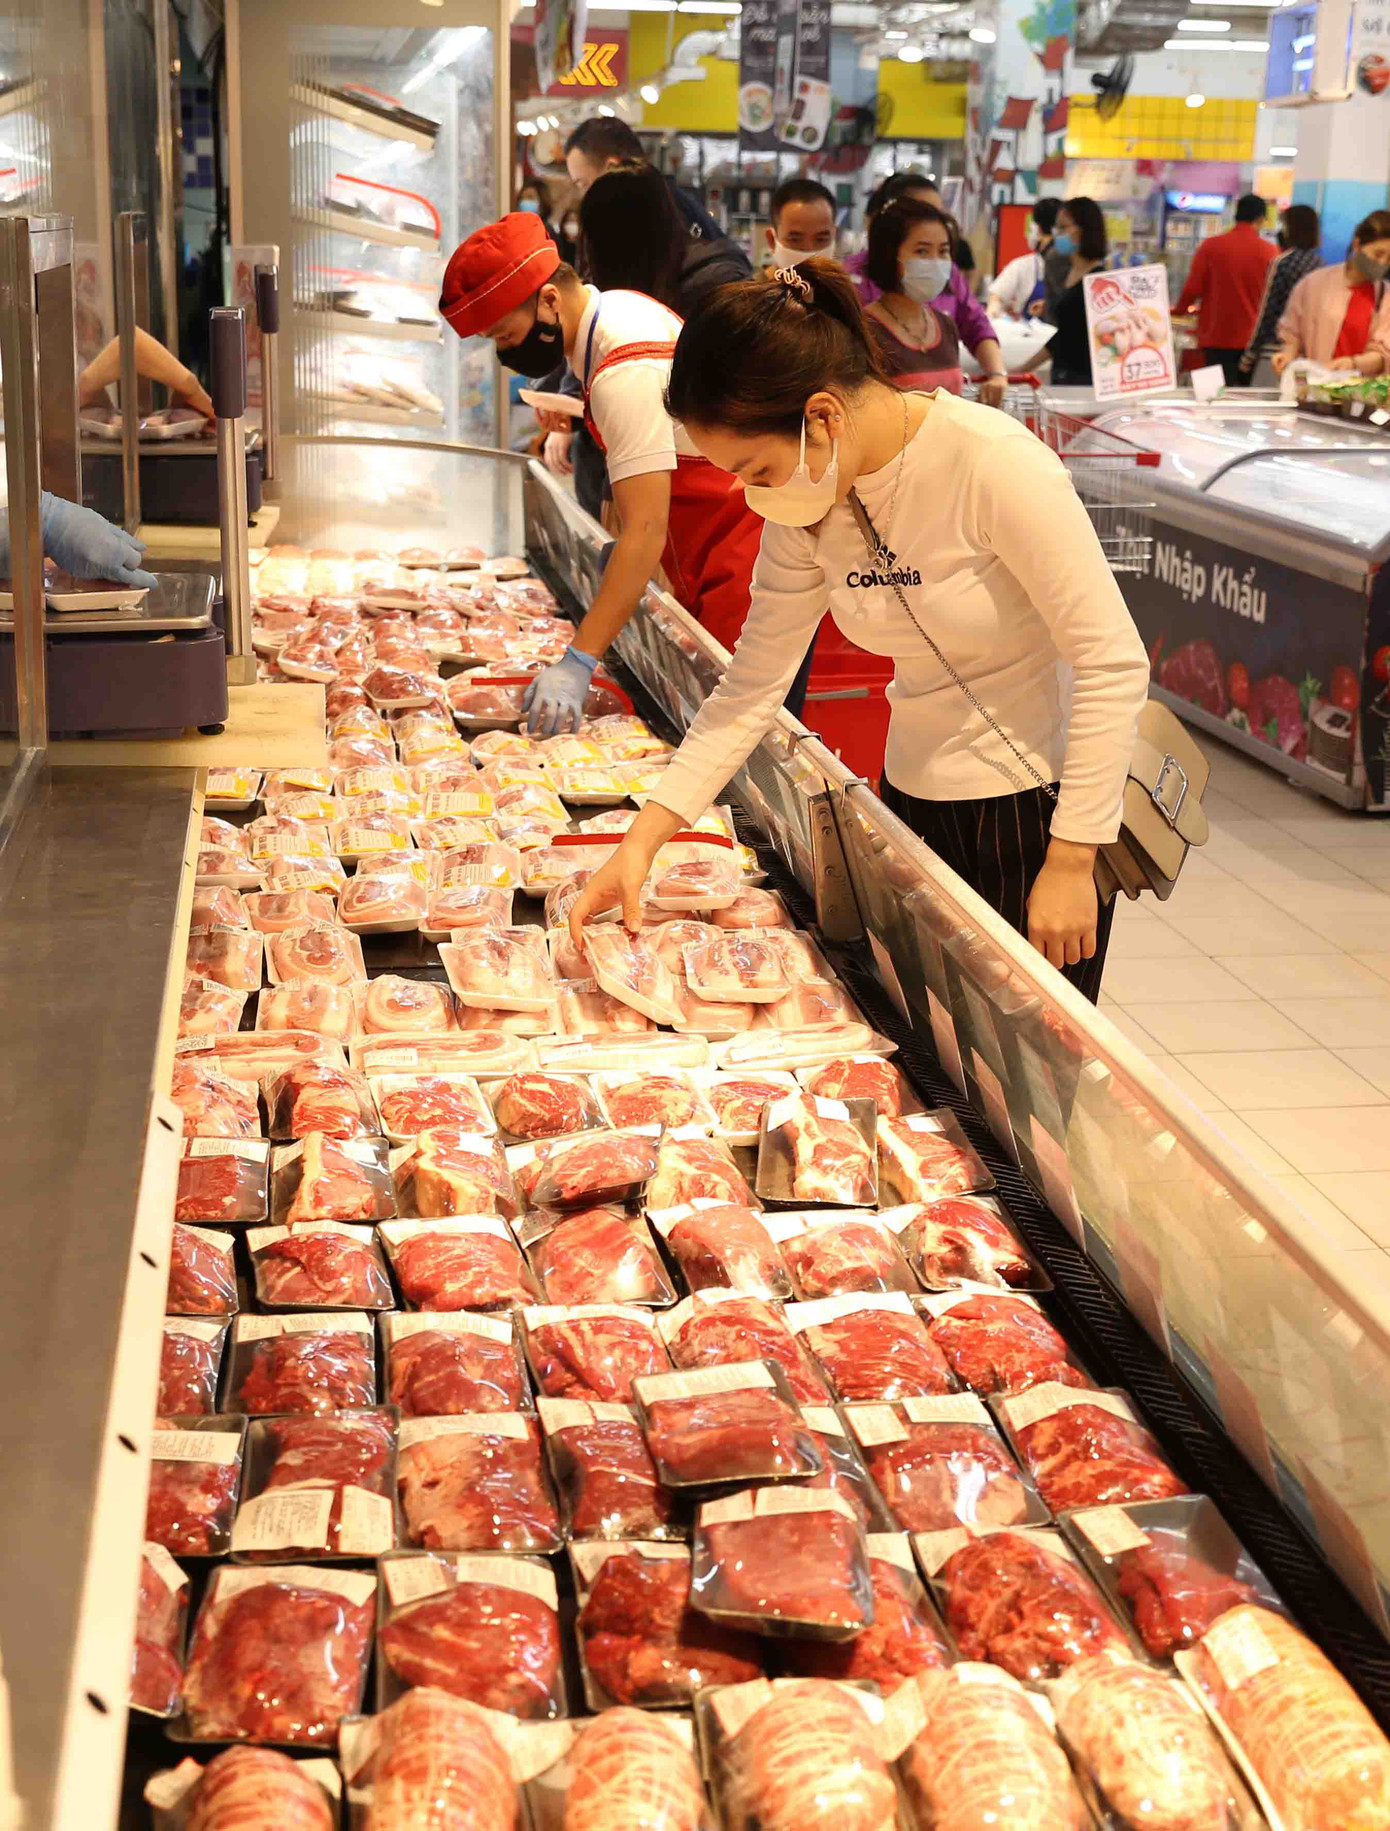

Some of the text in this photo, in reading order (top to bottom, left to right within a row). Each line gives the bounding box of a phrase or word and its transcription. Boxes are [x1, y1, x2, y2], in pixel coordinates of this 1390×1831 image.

[846, 566, 922, 588] Columbia
[1155, 541, 1206, 603] Nhập
[1211, 566, 1268, 624] Khẩu
